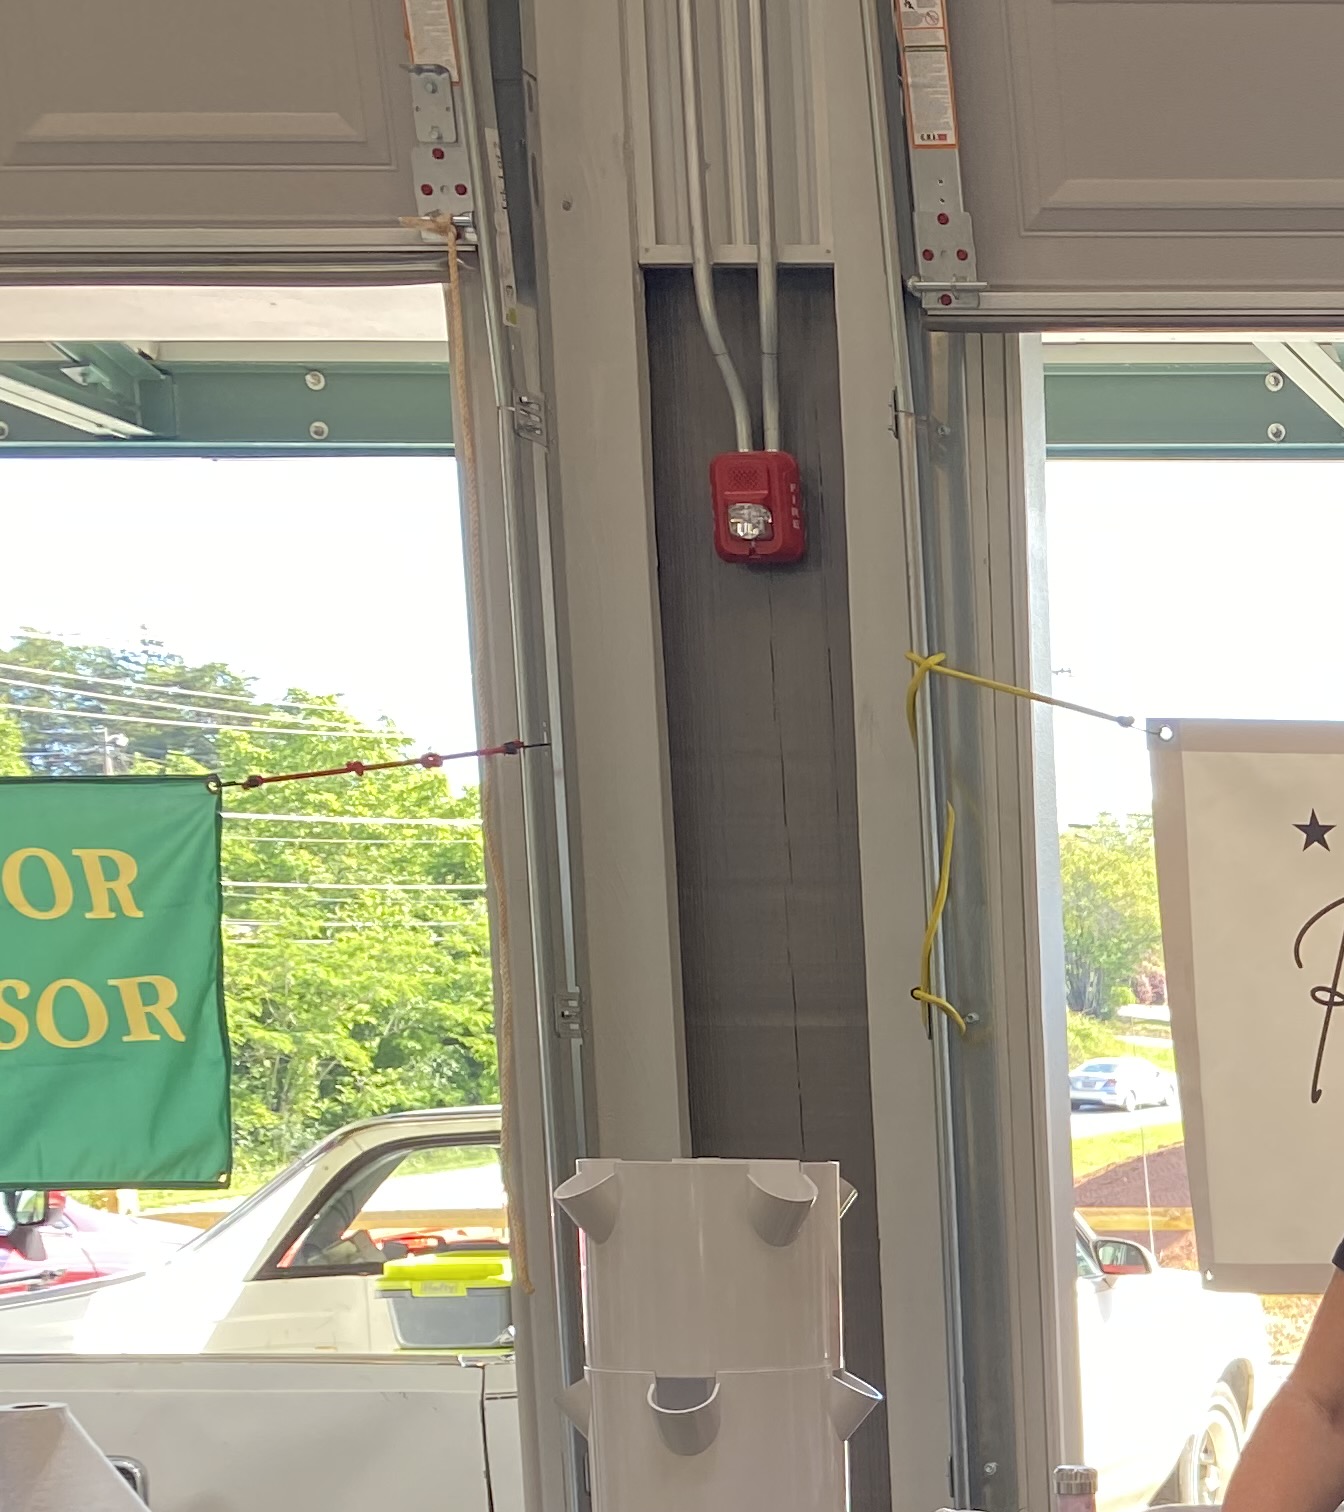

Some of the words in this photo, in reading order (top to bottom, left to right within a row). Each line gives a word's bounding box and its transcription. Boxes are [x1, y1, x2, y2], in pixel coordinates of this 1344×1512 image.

[789, 483, 800, 529] FIRE
[2, 847, 144, 920] OR
[0, 974, 186, 1050] SOR
